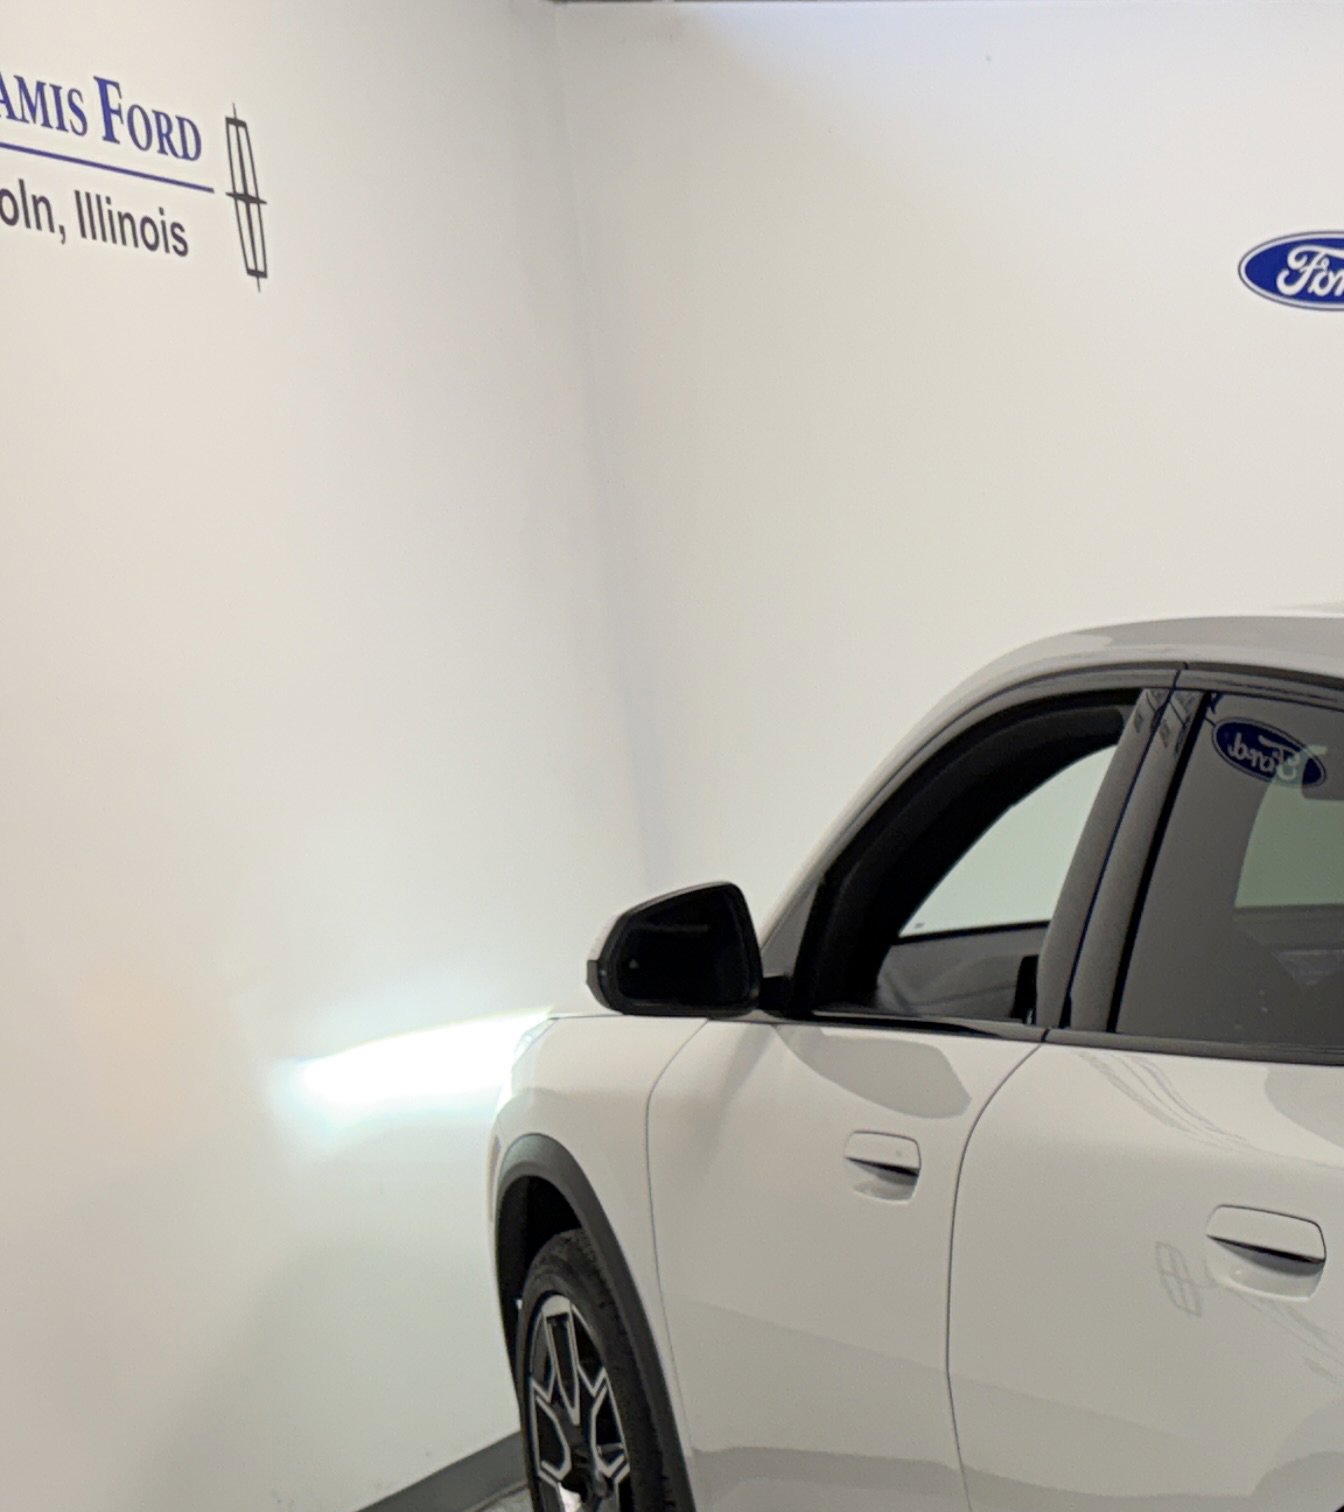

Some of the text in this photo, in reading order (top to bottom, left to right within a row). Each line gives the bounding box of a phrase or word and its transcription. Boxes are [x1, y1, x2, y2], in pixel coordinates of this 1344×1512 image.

[0, 72, 202, 162] AMIS FORD
[74, 189, 189, 257] Illinois
